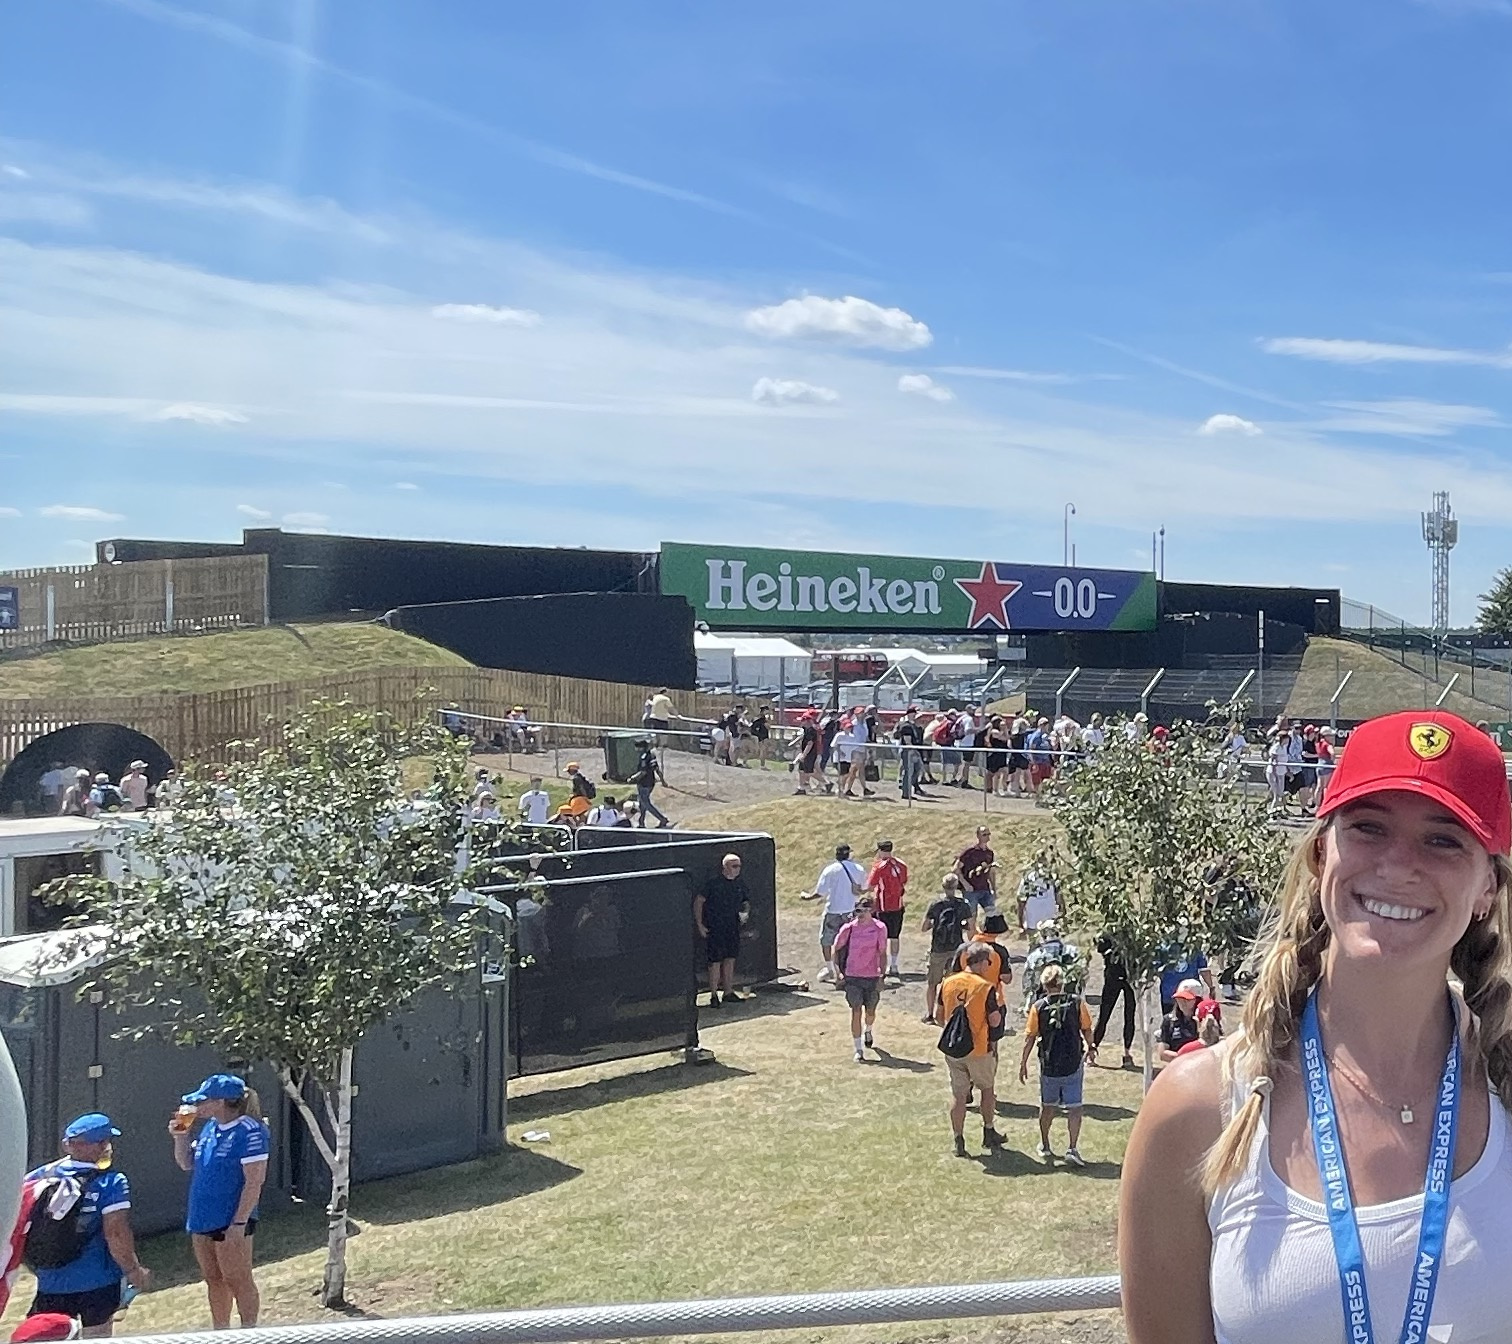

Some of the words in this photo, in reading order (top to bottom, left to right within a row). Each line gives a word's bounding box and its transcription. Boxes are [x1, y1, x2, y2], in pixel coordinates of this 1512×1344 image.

[1304, 1038, 1334, 1112] EXPRESS
[1319, 1117, 1347, 1211] AMERICAN
[1430, 1111, 1453, 1194] EXPRESS
